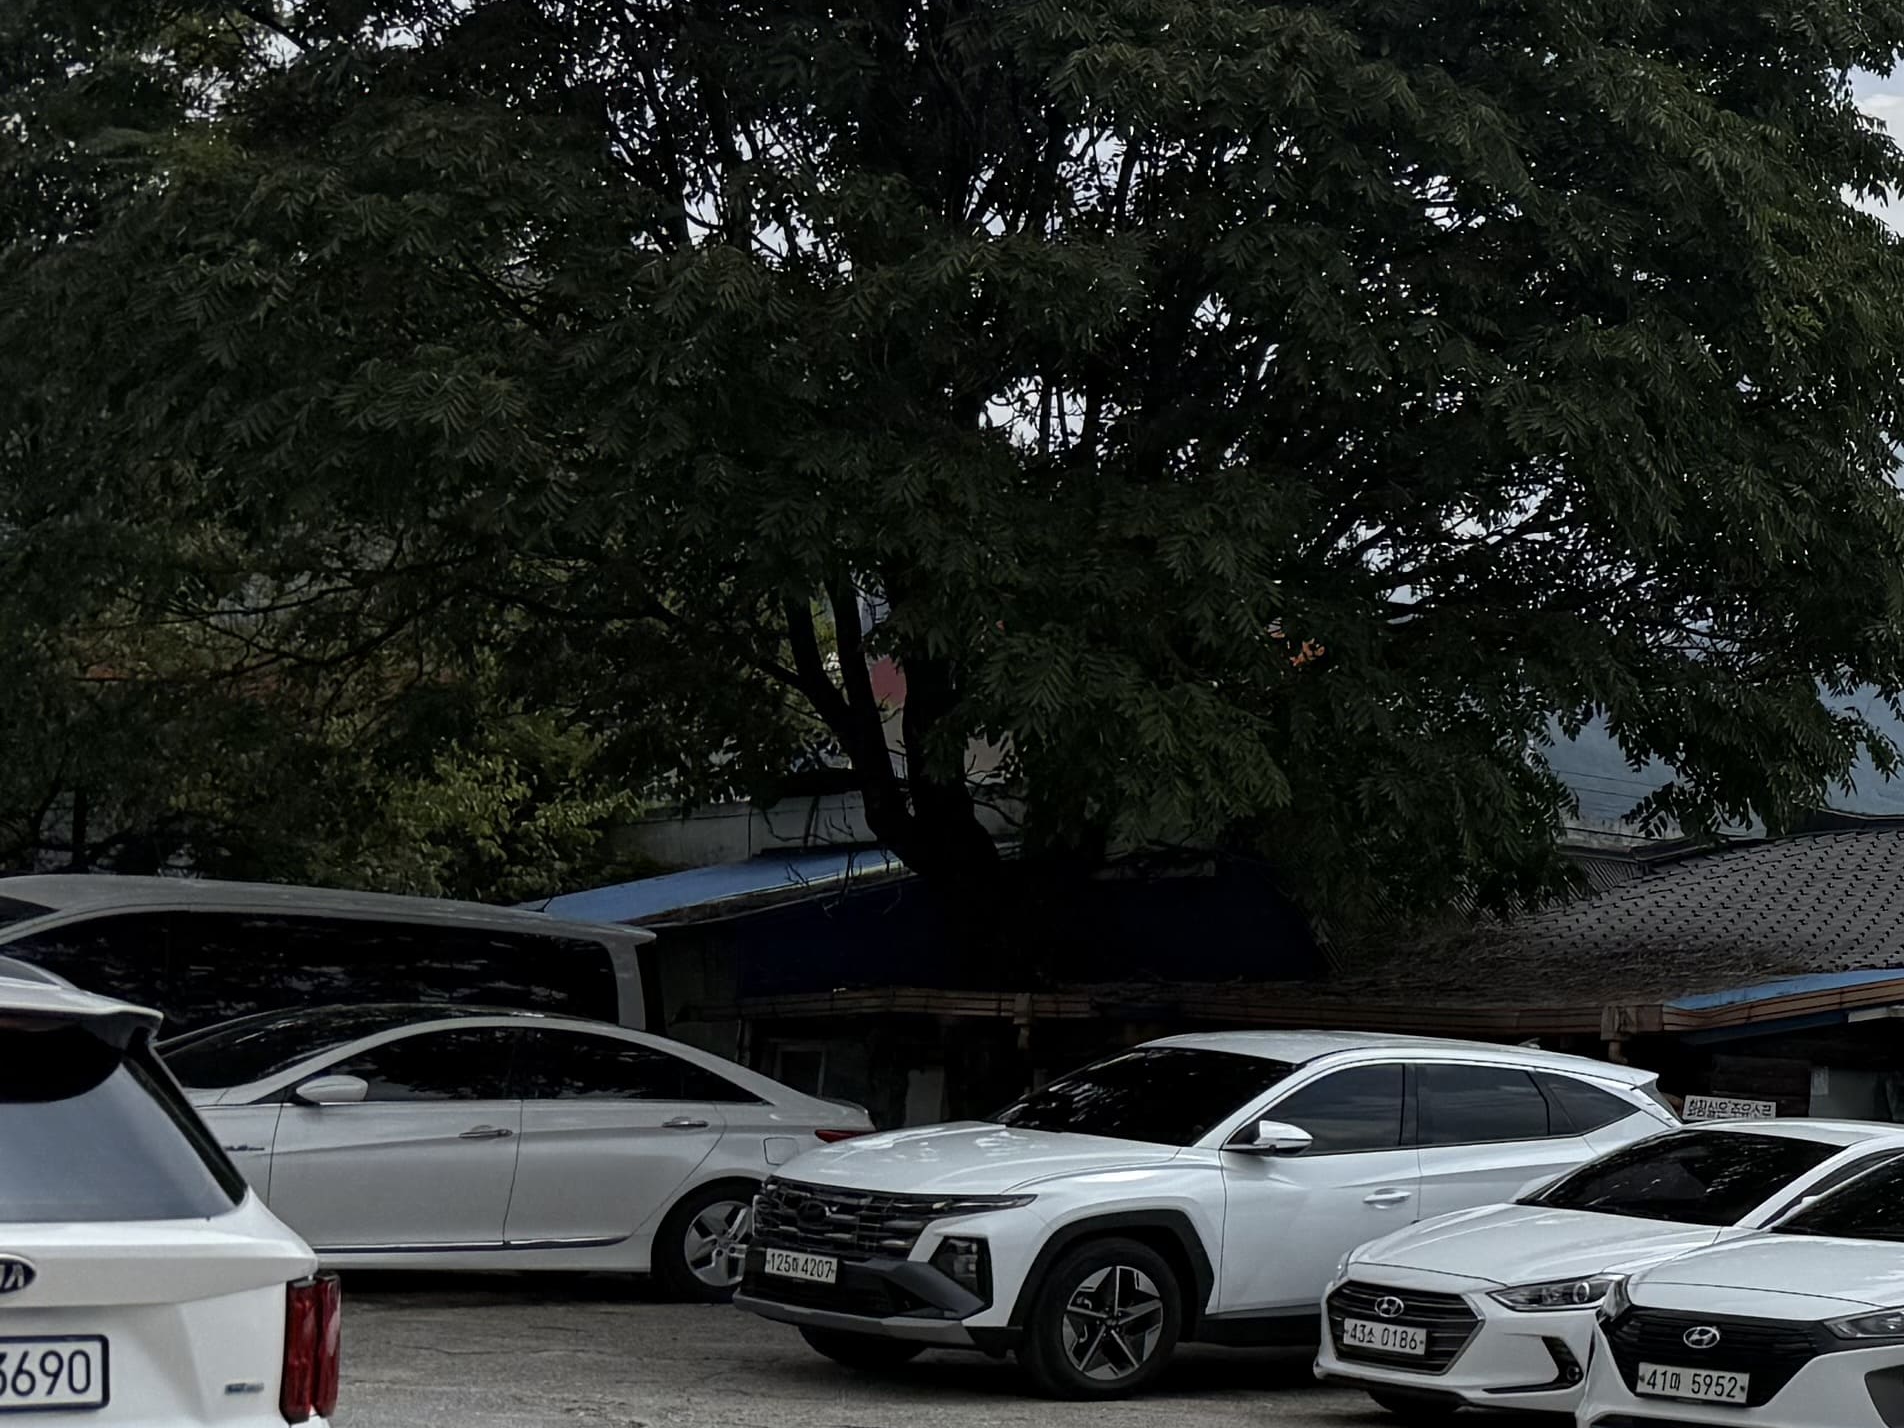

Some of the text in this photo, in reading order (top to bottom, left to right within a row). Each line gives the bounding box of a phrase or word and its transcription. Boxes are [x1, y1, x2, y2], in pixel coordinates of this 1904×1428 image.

[802, 1257, 833, 1278] 4207
[1381, 1327, 1418, 1350] 0186
[1691, 1373, 1738, 1399] 5952
